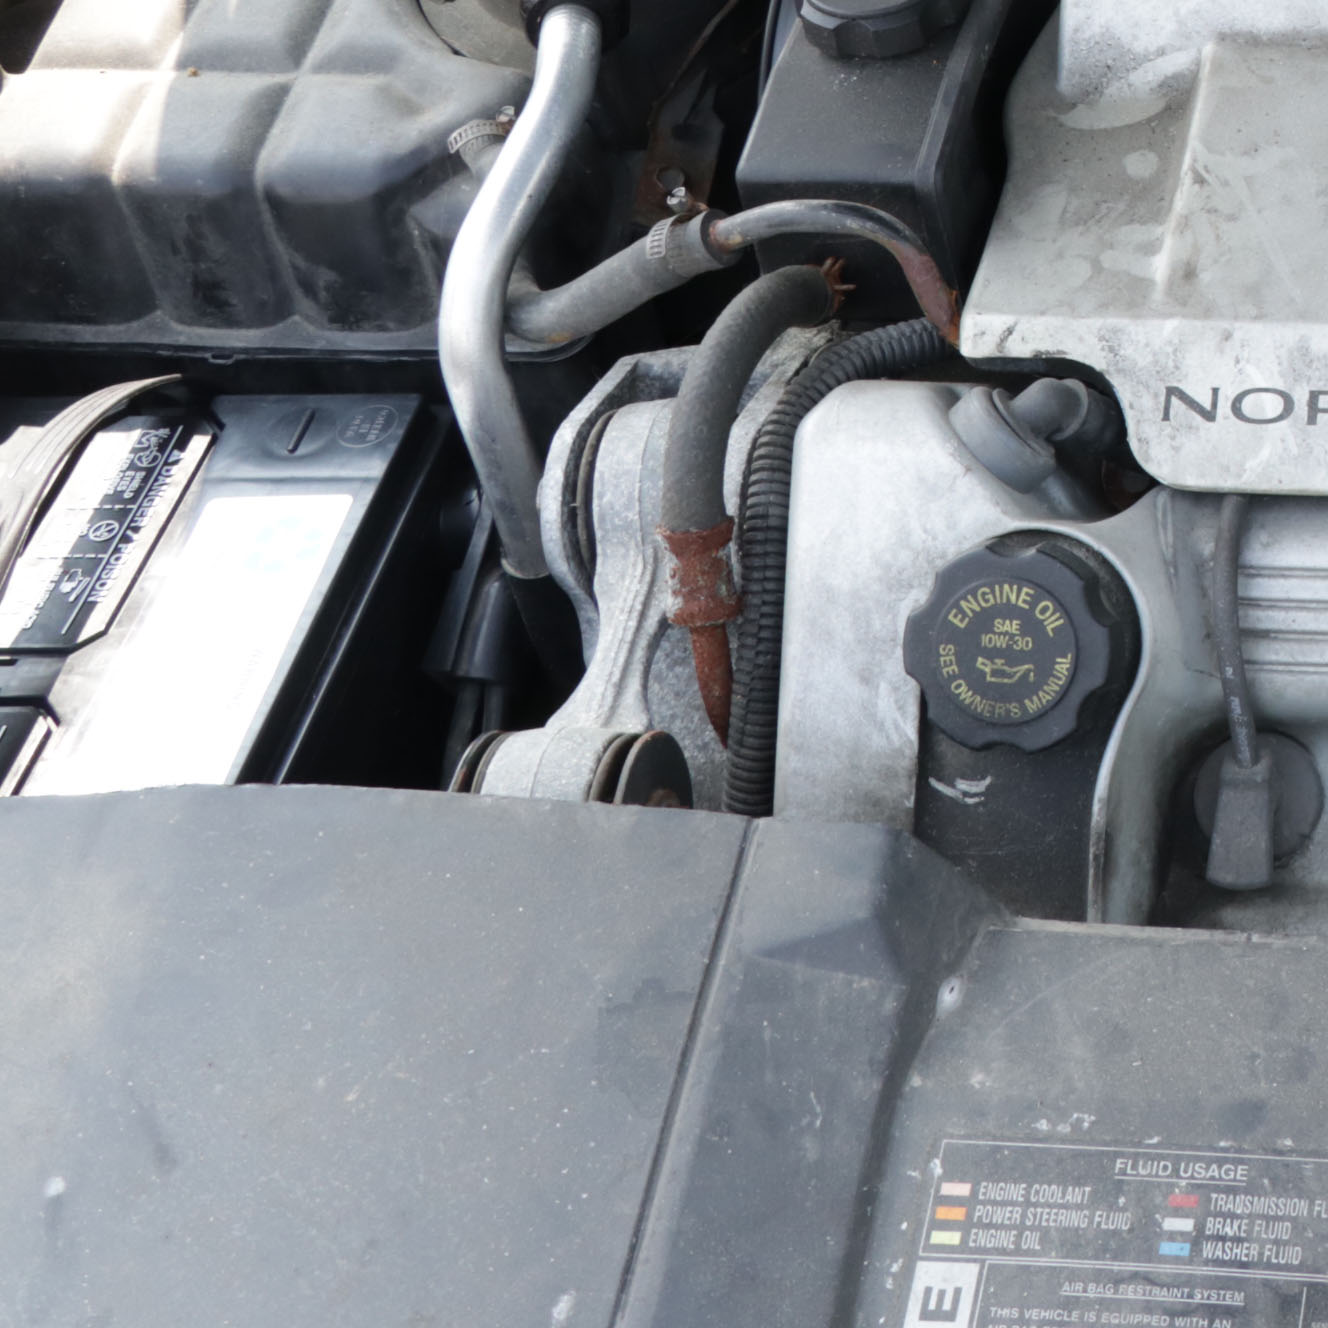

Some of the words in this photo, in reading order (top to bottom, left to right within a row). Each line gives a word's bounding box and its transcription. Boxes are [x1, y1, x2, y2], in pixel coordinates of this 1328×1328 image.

[86, 543, 131, 603] POISON
[948, 583, 1035, 629] ENGINE
[1034, 600, 1064, 637] OIL
[994, 619, 1021, 634] SAE
[981, 634, 1033, 651] 10W-30
[939, 644, 959, 678] SEE
[951, 679, 1021, 718] OWNER'S
[1023, 653, 1072, 713] MANUAL
[1114, 1158, 1172, 1176] FLUID
[1180, 1162, 1249, 1181] USAGE
[978, 1182, 1026, 1201] ENGINE
[1030, 1184, 1091, 1204] COOLANT
[1210, 1193, 1309, 1217] TRANSMISSION
[973, 1205, 1022, 1224] POWER
[1026, 1207, 1089, 1228] STEERING
[1093, 1210, 1132, 1230] FLUID
[1205, 1217, 1248, 1236] BRAKE
[1253, 1221, 1292, 1240] FLUID
[969, 1229, 1016, 1249] ENGINE
[1021, 1231, 1041, 1250] OIL
[1202, 1241, 1258, 1262] WASHER
[1264, 1244, 1302, 1265] FLUID
[1062, 1281, 1085, 1293] AIR
[1087, 1283, 1114, 1295] BAG
[1118, 1284, 1190, 1299] RESTRAINT
[1194, 1288, 1245, 1302] SYSTEM
[989, 1306, 1019, 1319] THIS
[1024, 1308, 1081, 1321] VEHICLE
[1084, 1310, 1097, 1322] IS
[1101, 1311, 1170, 1327] EQUIPPED
[1174, 1315, 1207, 1328] WITH
[1210, 1317, 1232, 1328] AN
